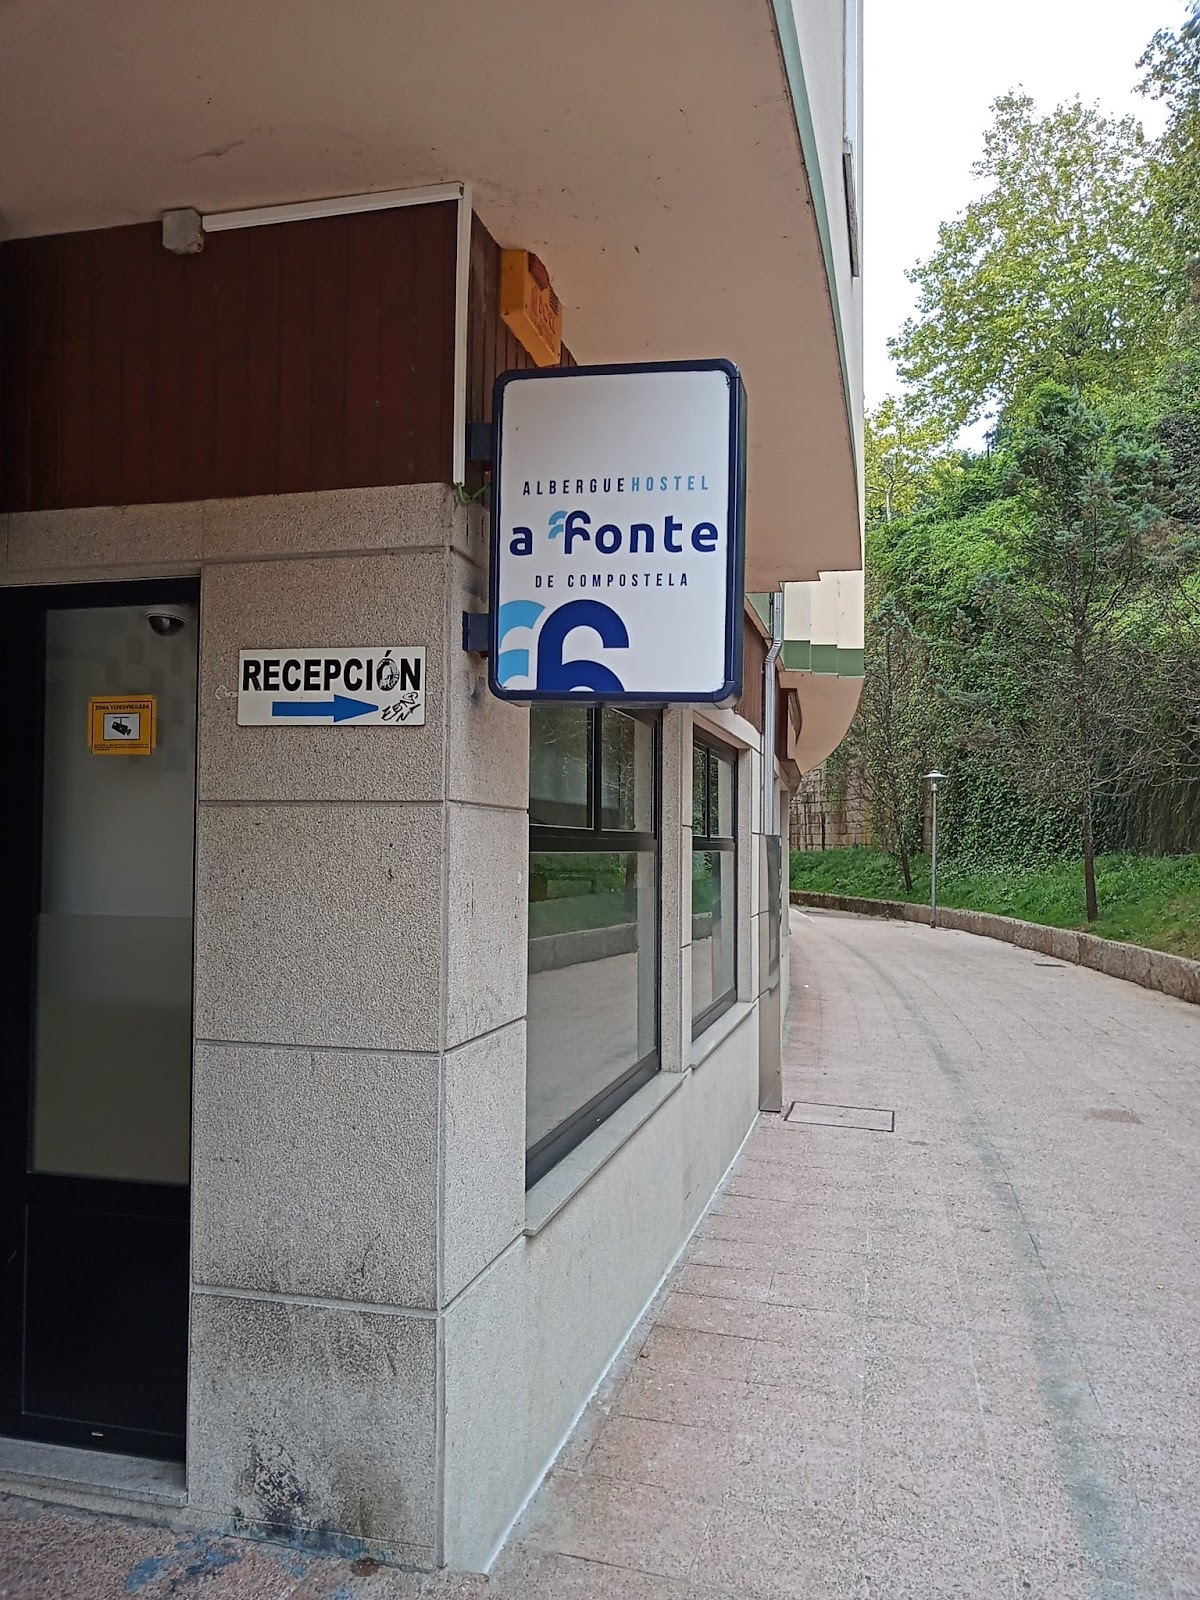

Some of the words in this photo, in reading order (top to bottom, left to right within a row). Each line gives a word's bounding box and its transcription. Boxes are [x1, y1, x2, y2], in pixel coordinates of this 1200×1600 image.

[509, 527, 533, 556] a
[549, 510, 719, 555] fonte
[535, 575, 555, 588] DE
[567, 573, 688, 588] COMPOSTELA
[242, 649, 421, 692] RECEPCIÓN
